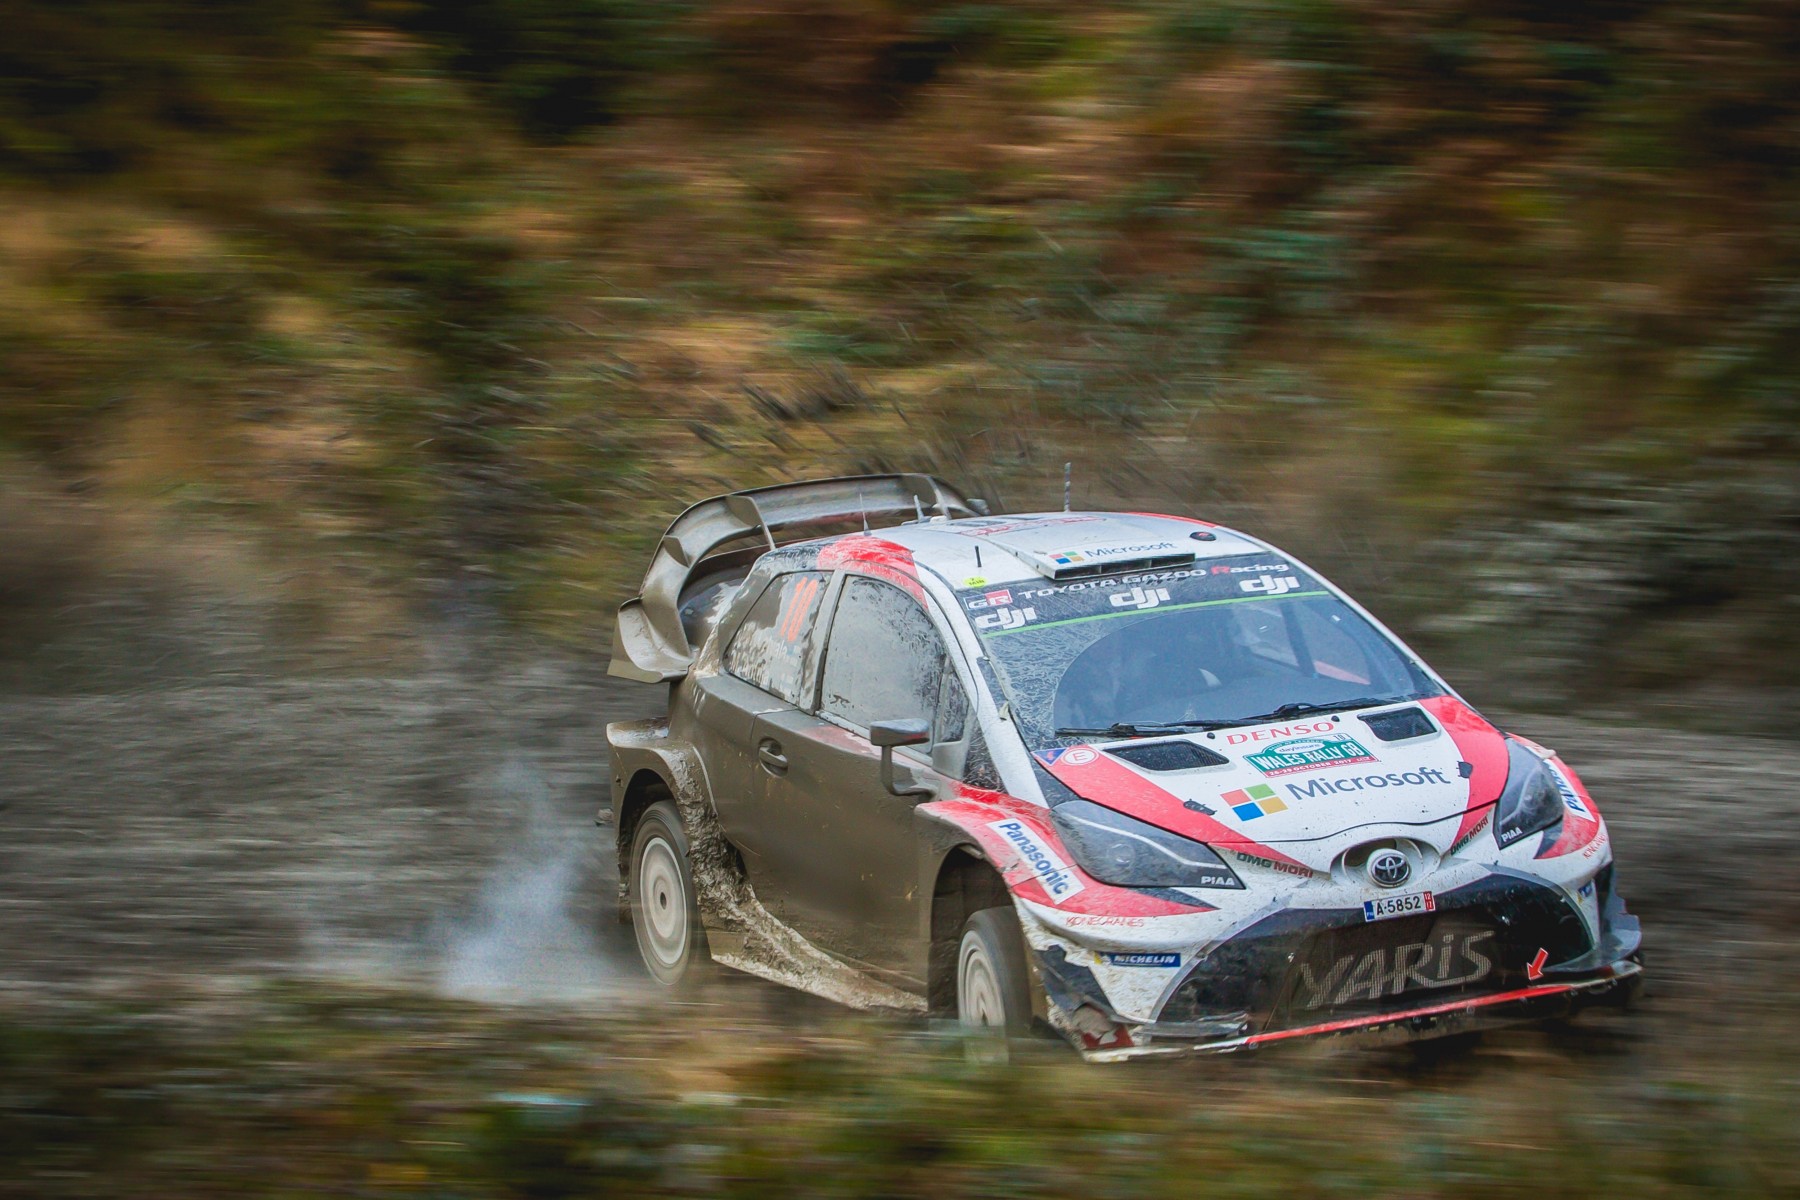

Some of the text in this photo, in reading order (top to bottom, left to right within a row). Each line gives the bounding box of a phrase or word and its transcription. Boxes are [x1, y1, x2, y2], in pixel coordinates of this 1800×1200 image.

[1085, 542, 1178, 557] Microsoft
[1018, 564, 1289, 599] TOYOTA GAZOO Racing
[1226, 722, 1334, 745] DENSO
[1072, 752, 1088, 761] E
[1251, 753, 1306, 770] WALES
[1303, 746, 1345, 762] RALLY
[1341, 742, 1365, 757] GB
[1293, 761, 1331, 771] OCTOBER
[1285, 767, 1451, 800] Microsoft
[1501, 826, 1523, 842] PIAA
[998, 822, 1069, 895] Panasonic
[1236, 852, 1314, 878] DMG MORI
[1201, 876, 1235, 886] PIAA
[1114, 955, 1176, 964] MICHELIN
